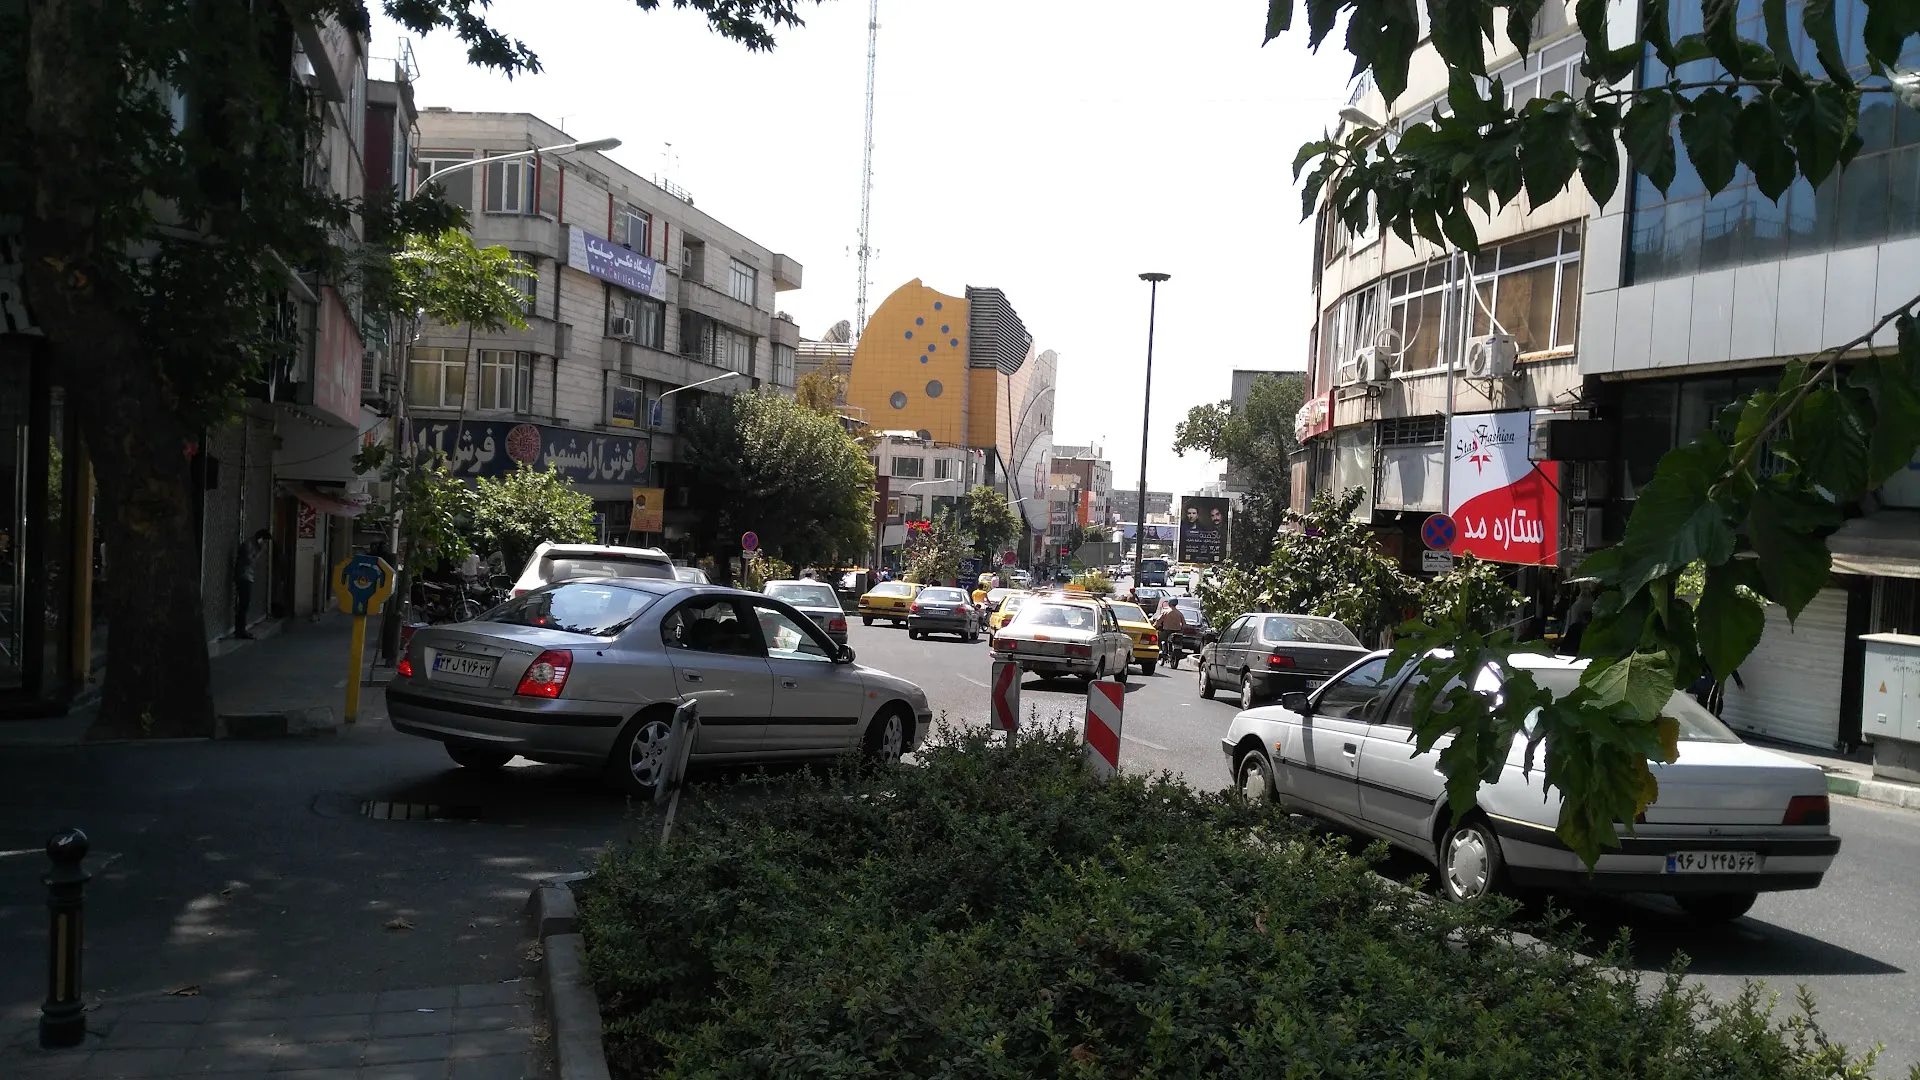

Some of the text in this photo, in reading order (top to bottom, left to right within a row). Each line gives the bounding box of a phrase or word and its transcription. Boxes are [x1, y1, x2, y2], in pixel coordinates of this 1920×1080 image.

[587, 240, 614, 267] چیلیک
[614, 254, 633, 268] عکس
[634, 259, 652, 281] پایگاه
[1476, 424, 1515, 445] Fashion
[441, 427, 496, 473] فرش
[601, 441, 634, 480] فرش
[1464, 508, 1544, 550] ستاره مد
